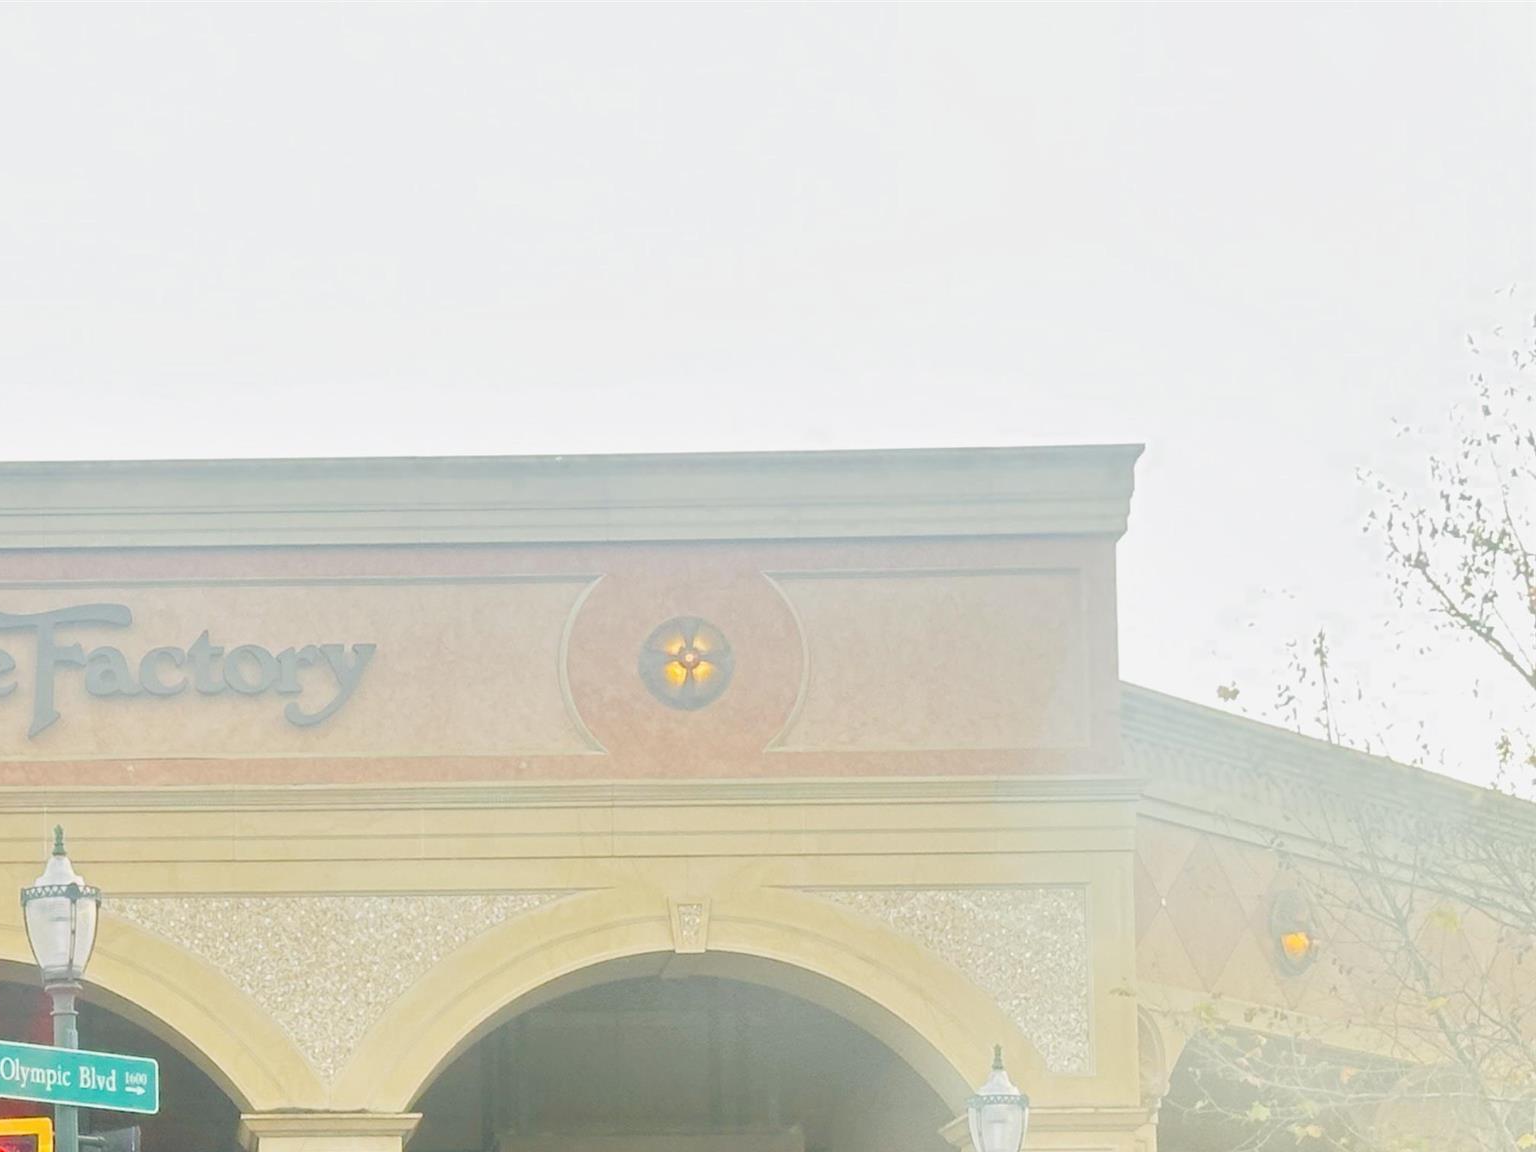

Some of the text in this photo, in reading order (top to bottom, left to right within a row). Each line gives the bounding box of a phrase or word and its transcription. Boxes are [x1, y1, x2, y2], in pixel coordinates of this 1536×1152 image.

[0, 1057, 117, 1092] Olympic Blvd
[124, 1071, 148, 1086] 1600
